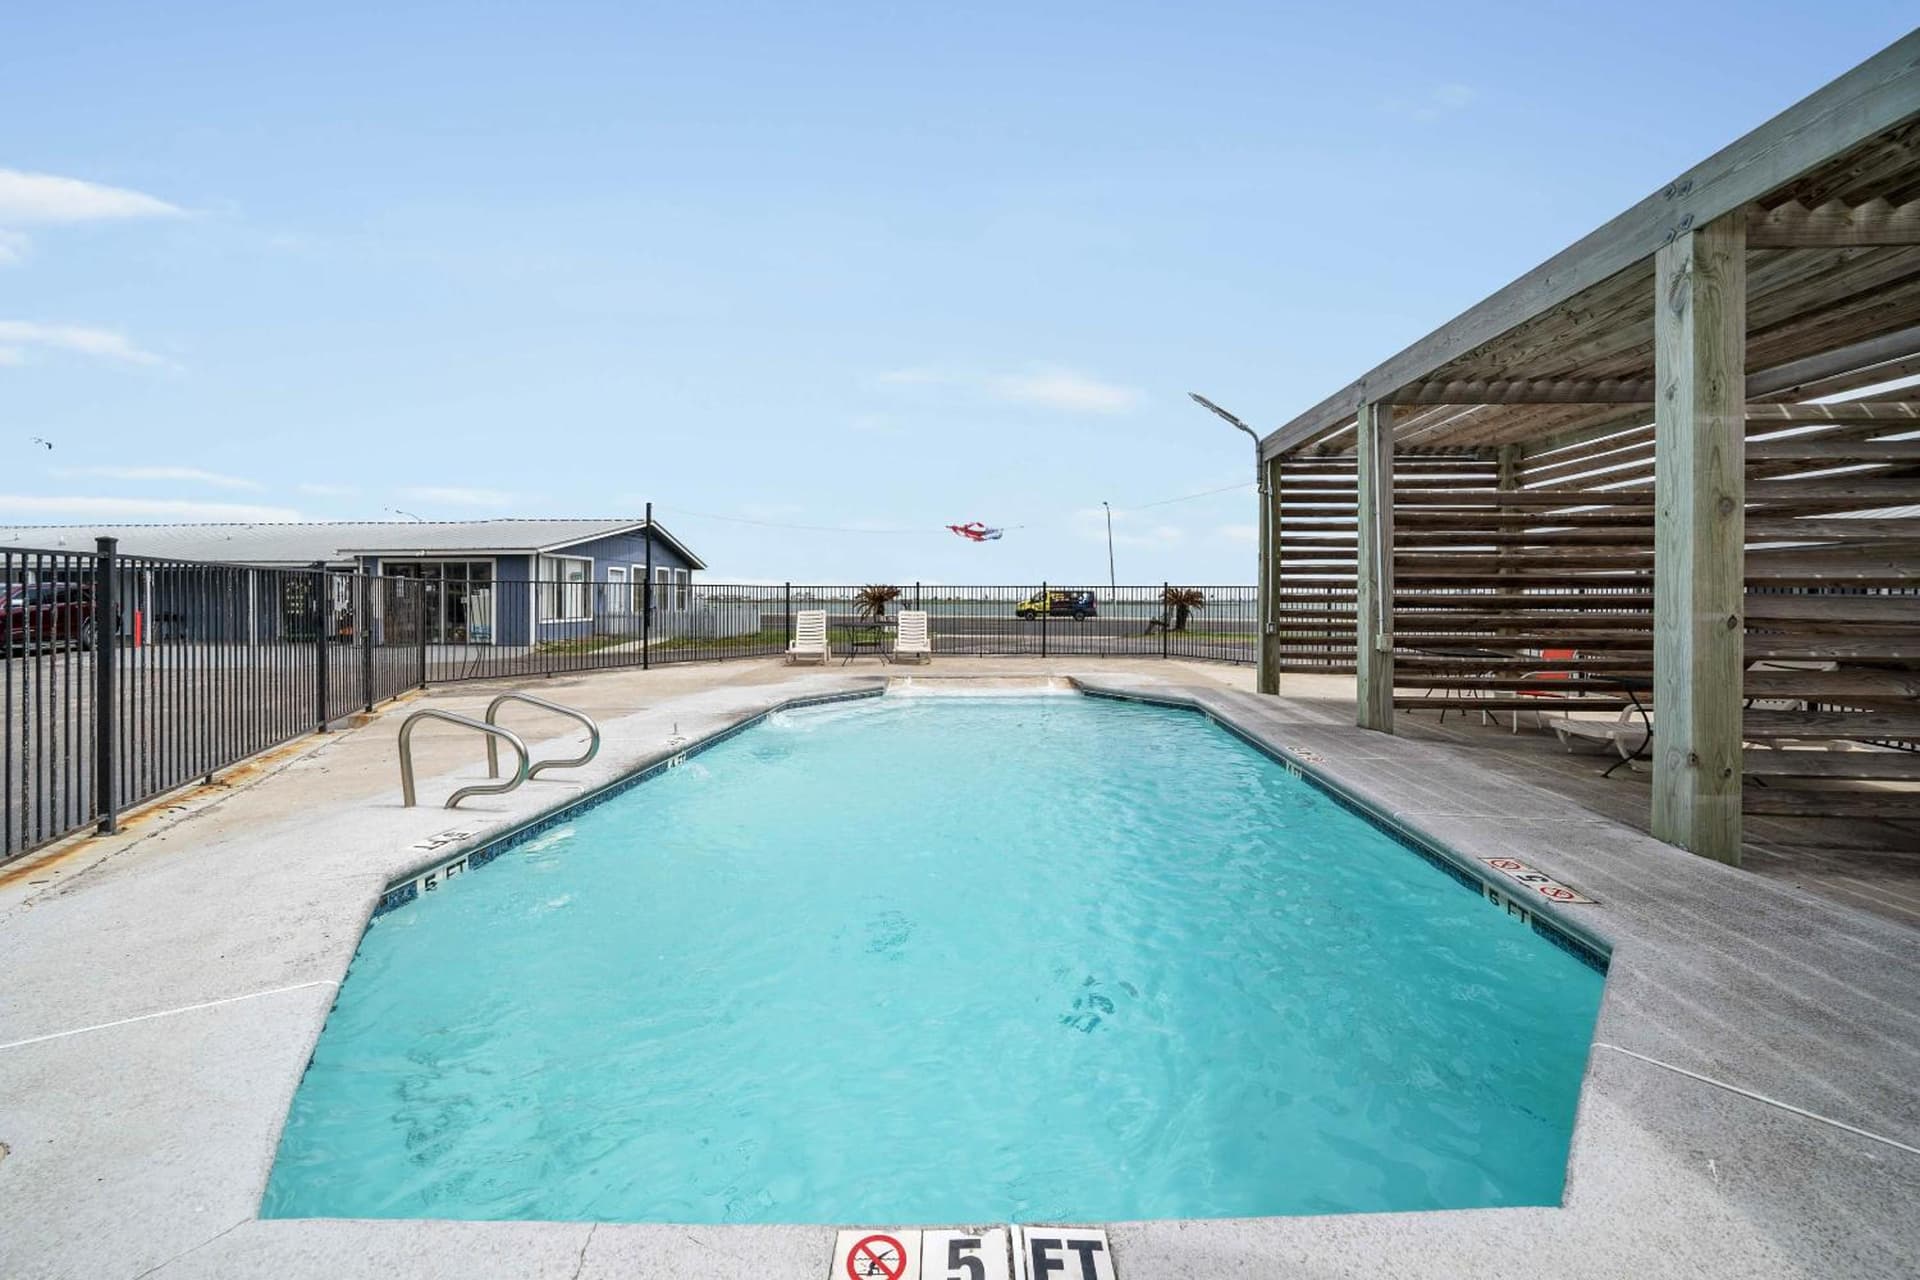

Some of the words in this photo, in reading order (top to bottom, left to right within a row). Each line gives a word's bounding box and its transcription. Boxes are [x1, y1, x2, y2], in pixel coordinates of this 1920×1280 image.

[424, 873, 438, 892] 5
[446, 859, 466, 879] FT
[1488, 887, 1500, 906] 5
[1508, 899, 1529, 923] FT
[946, 1238, 985, 1280] 5
[1030, 1238, 1104, 1280] FT
